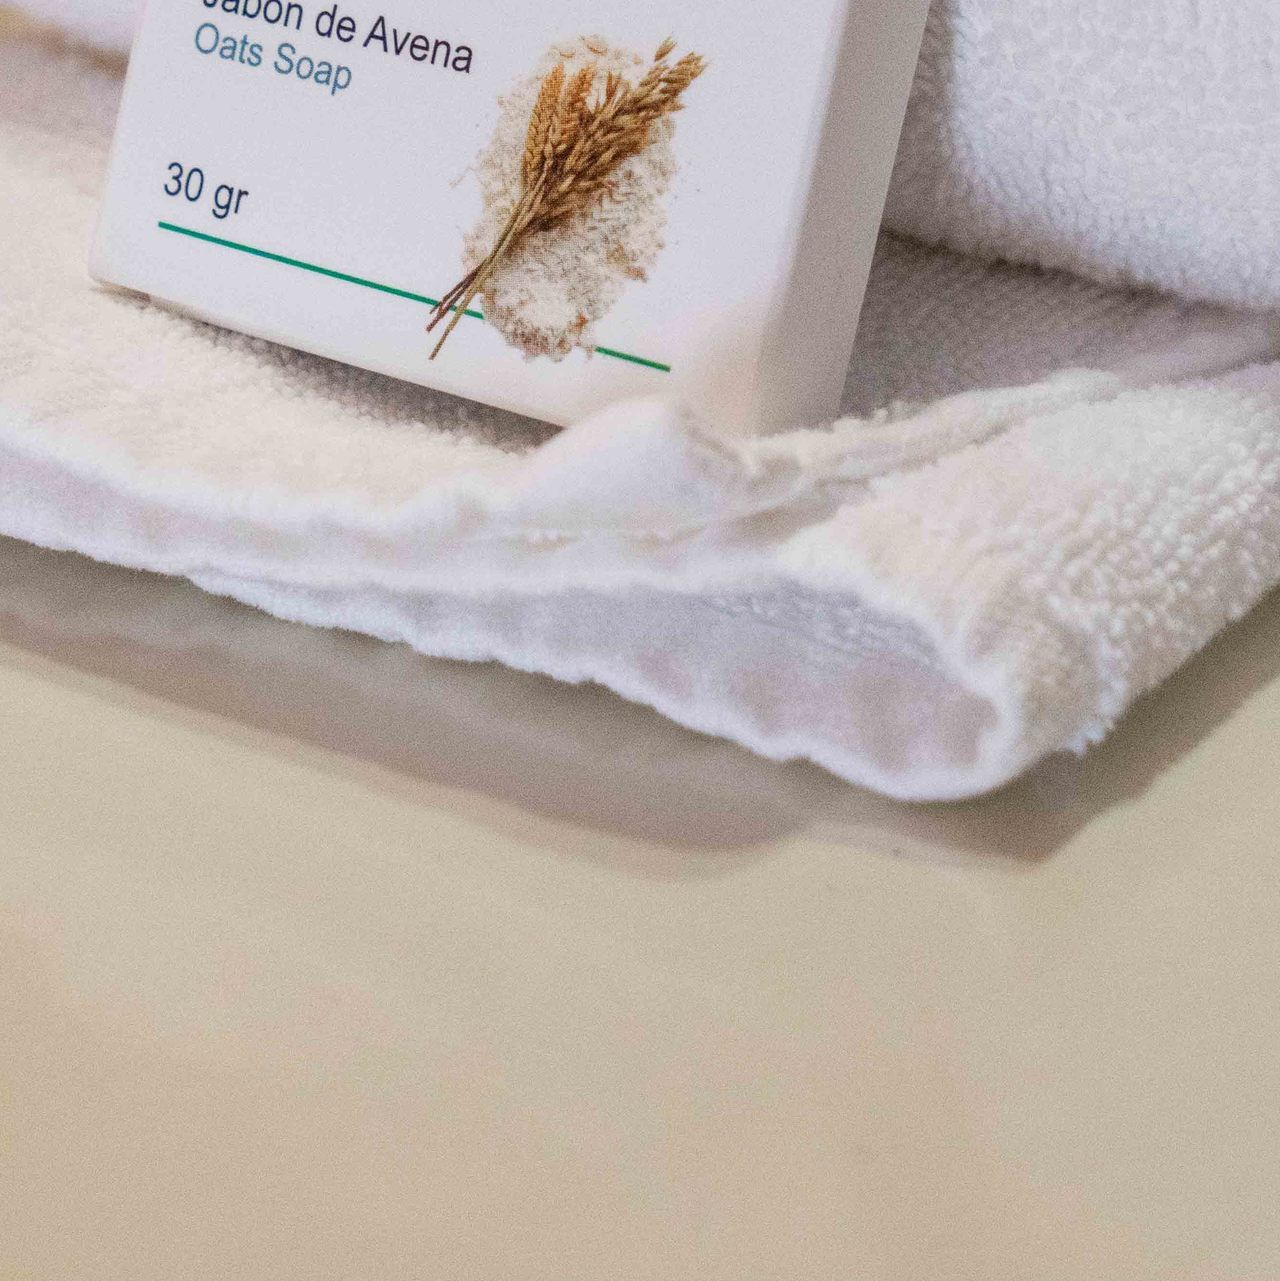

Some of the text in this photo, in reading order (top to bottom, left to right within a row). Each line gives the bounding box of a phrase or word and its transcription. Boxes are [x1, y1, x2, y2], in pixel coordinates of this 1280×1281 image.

[195, 22, 352, 96] Oats Soap
[315, 4, 356, 43] de
[363, 15, 473, 74] Avena
[164, 162, 249, 220] 30 gr
